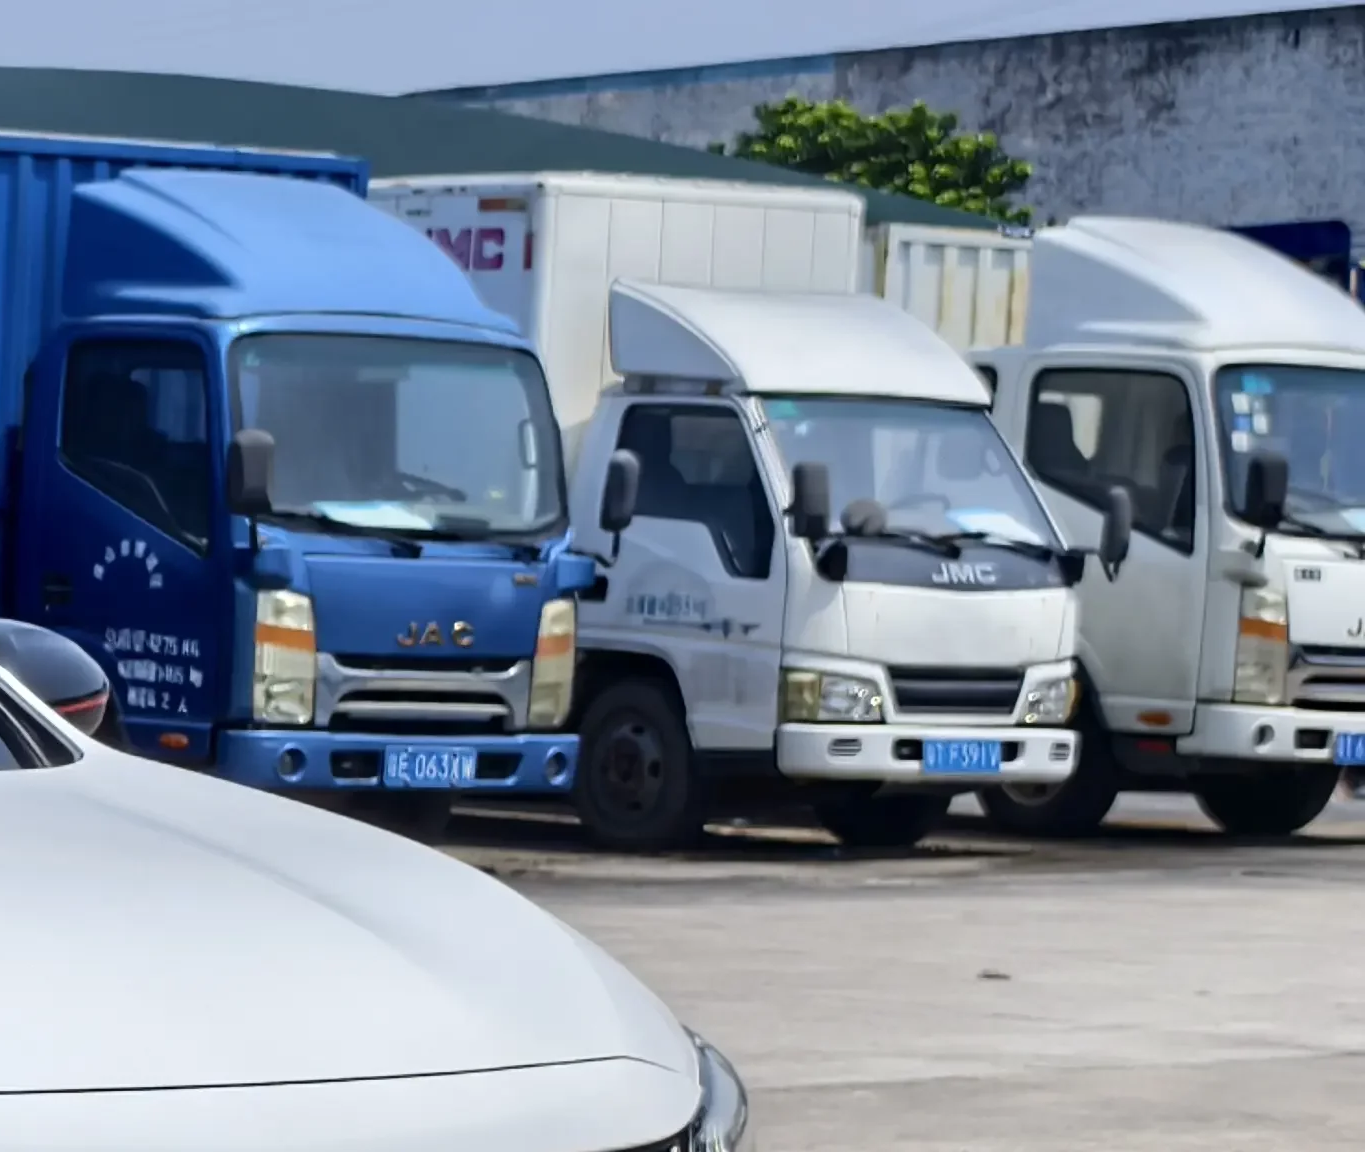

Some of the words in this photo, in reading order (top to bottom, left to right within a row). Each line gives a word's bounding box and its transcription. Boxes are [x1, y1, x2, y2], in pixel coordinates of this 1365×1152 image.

[426, 227, 504, 271] MC
[931, 562, 997, 584] JMC
[396, 620, 474, 647] JAC
